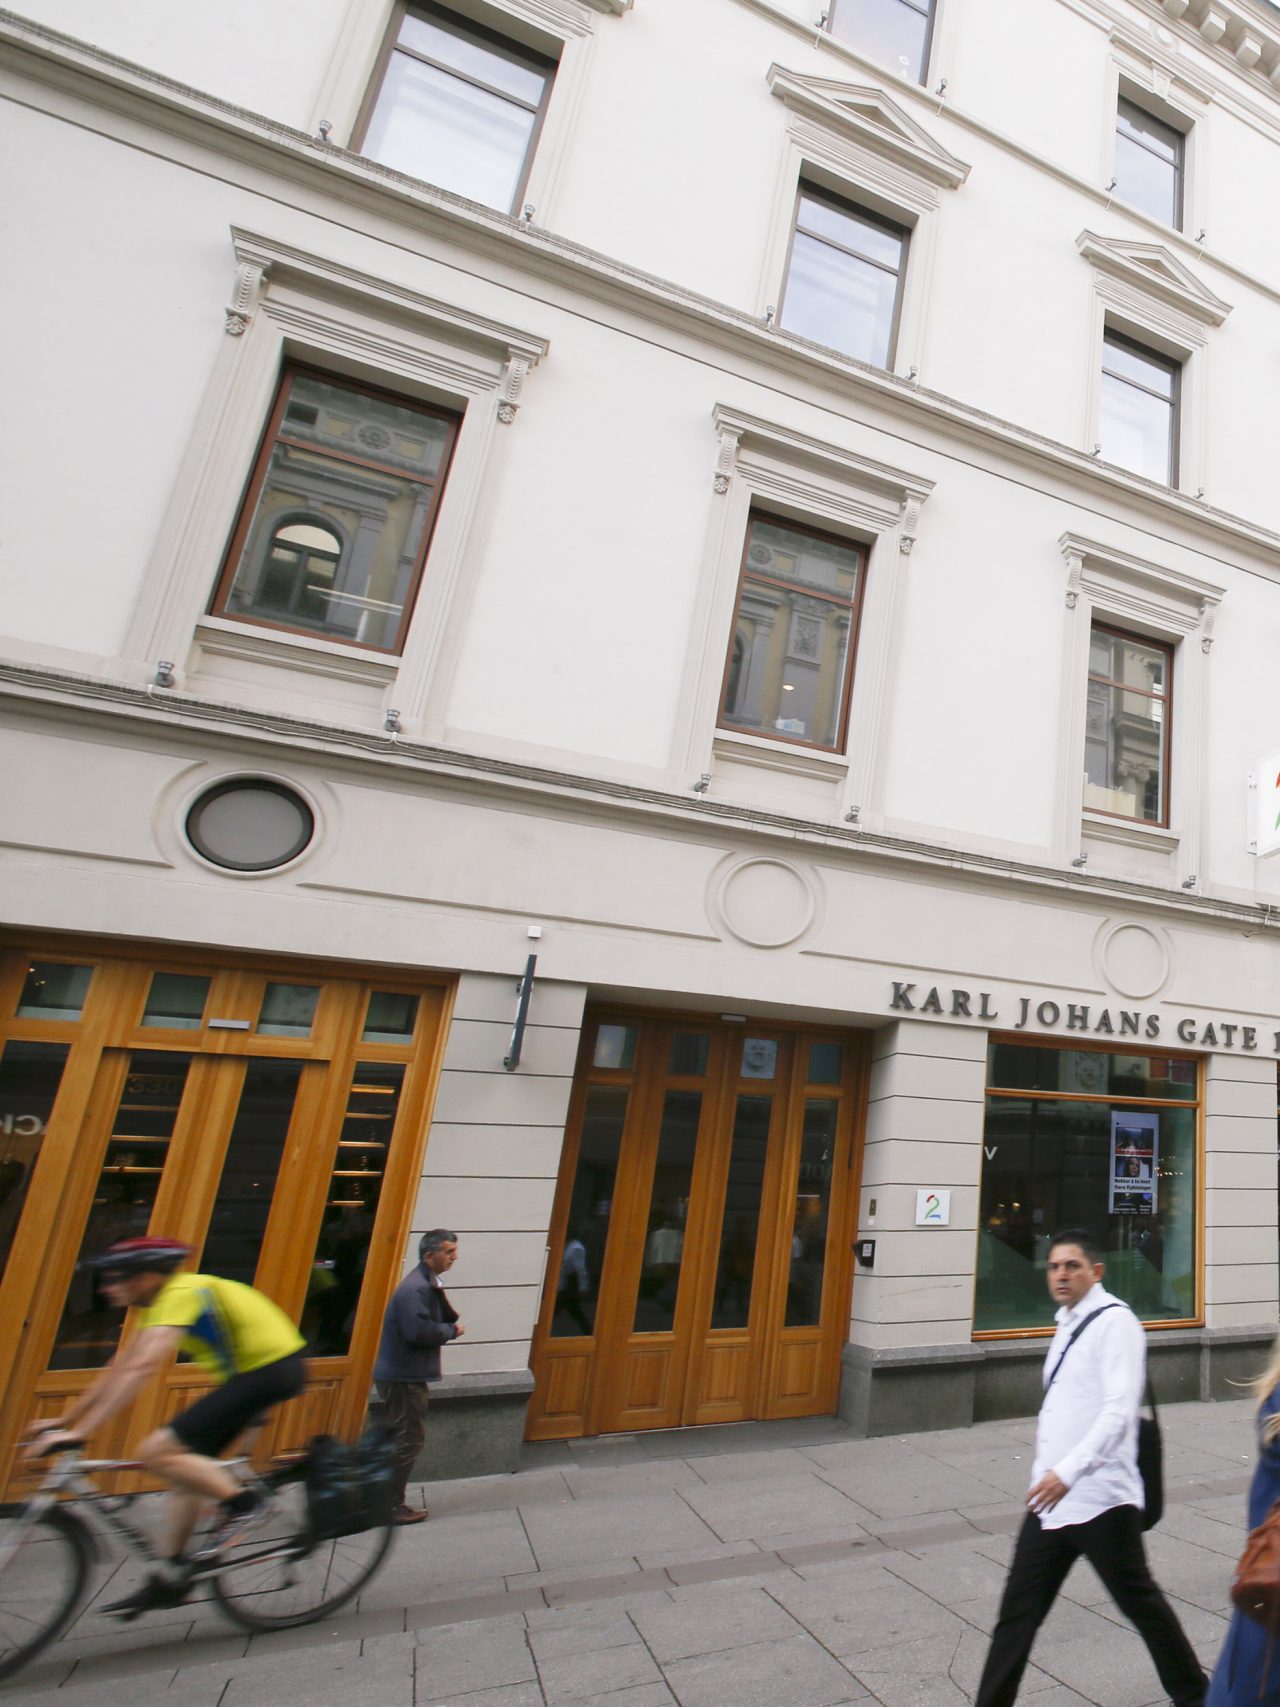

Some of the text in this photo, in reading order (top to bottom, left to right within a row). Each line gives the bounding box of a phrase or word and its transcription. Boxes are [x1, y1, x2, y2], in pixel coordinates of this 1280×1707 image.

[889, 981, 999, 1019] KARL
[1014, 997, 1161, 1038] JOHANS
[1177, 1018, 1258, 1049] GATE
[925, 1194, 941, 1220] 2
